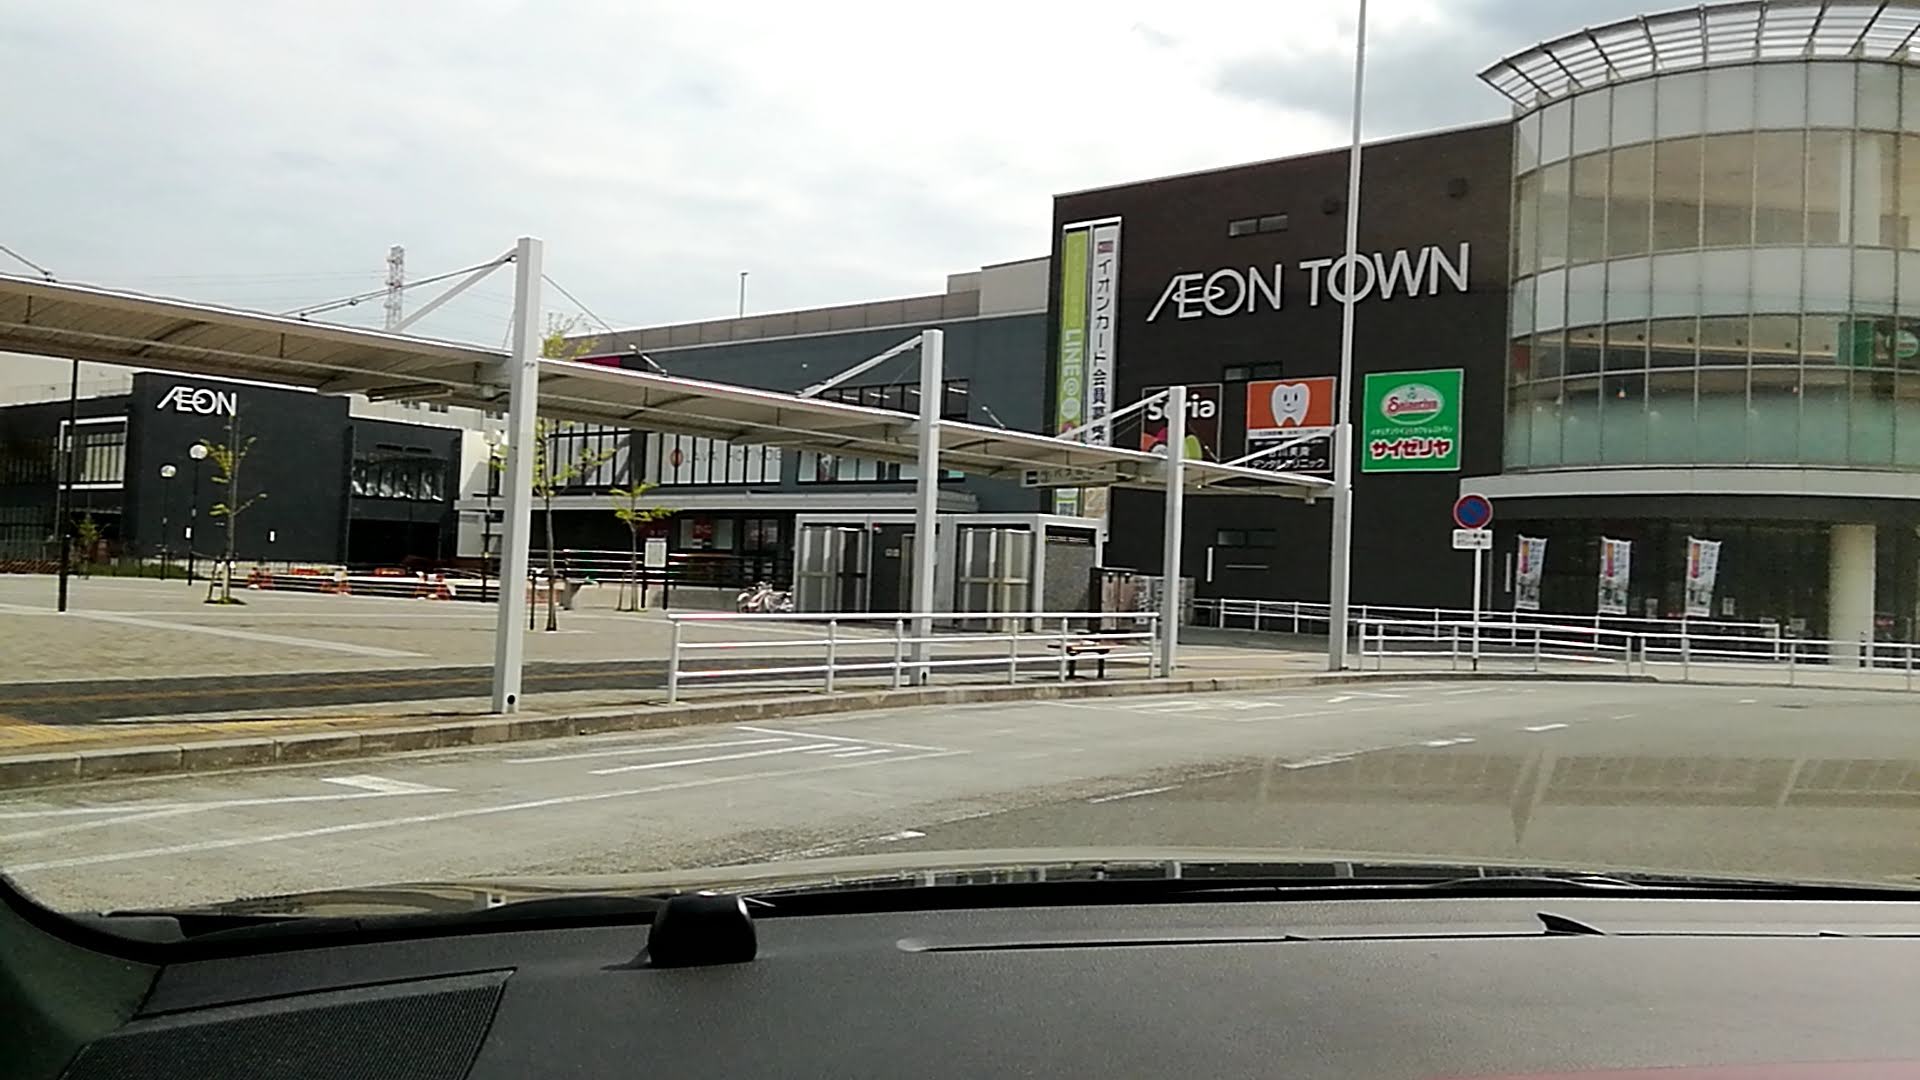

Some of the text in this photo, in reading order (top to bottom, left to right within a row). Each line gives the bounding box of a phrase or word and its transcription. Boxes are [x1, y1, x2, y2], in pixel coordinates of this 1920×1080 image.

[1300, 242, 1469, 306] TOWN
[1370, 437, 1453, 460] サイゼリヤ
